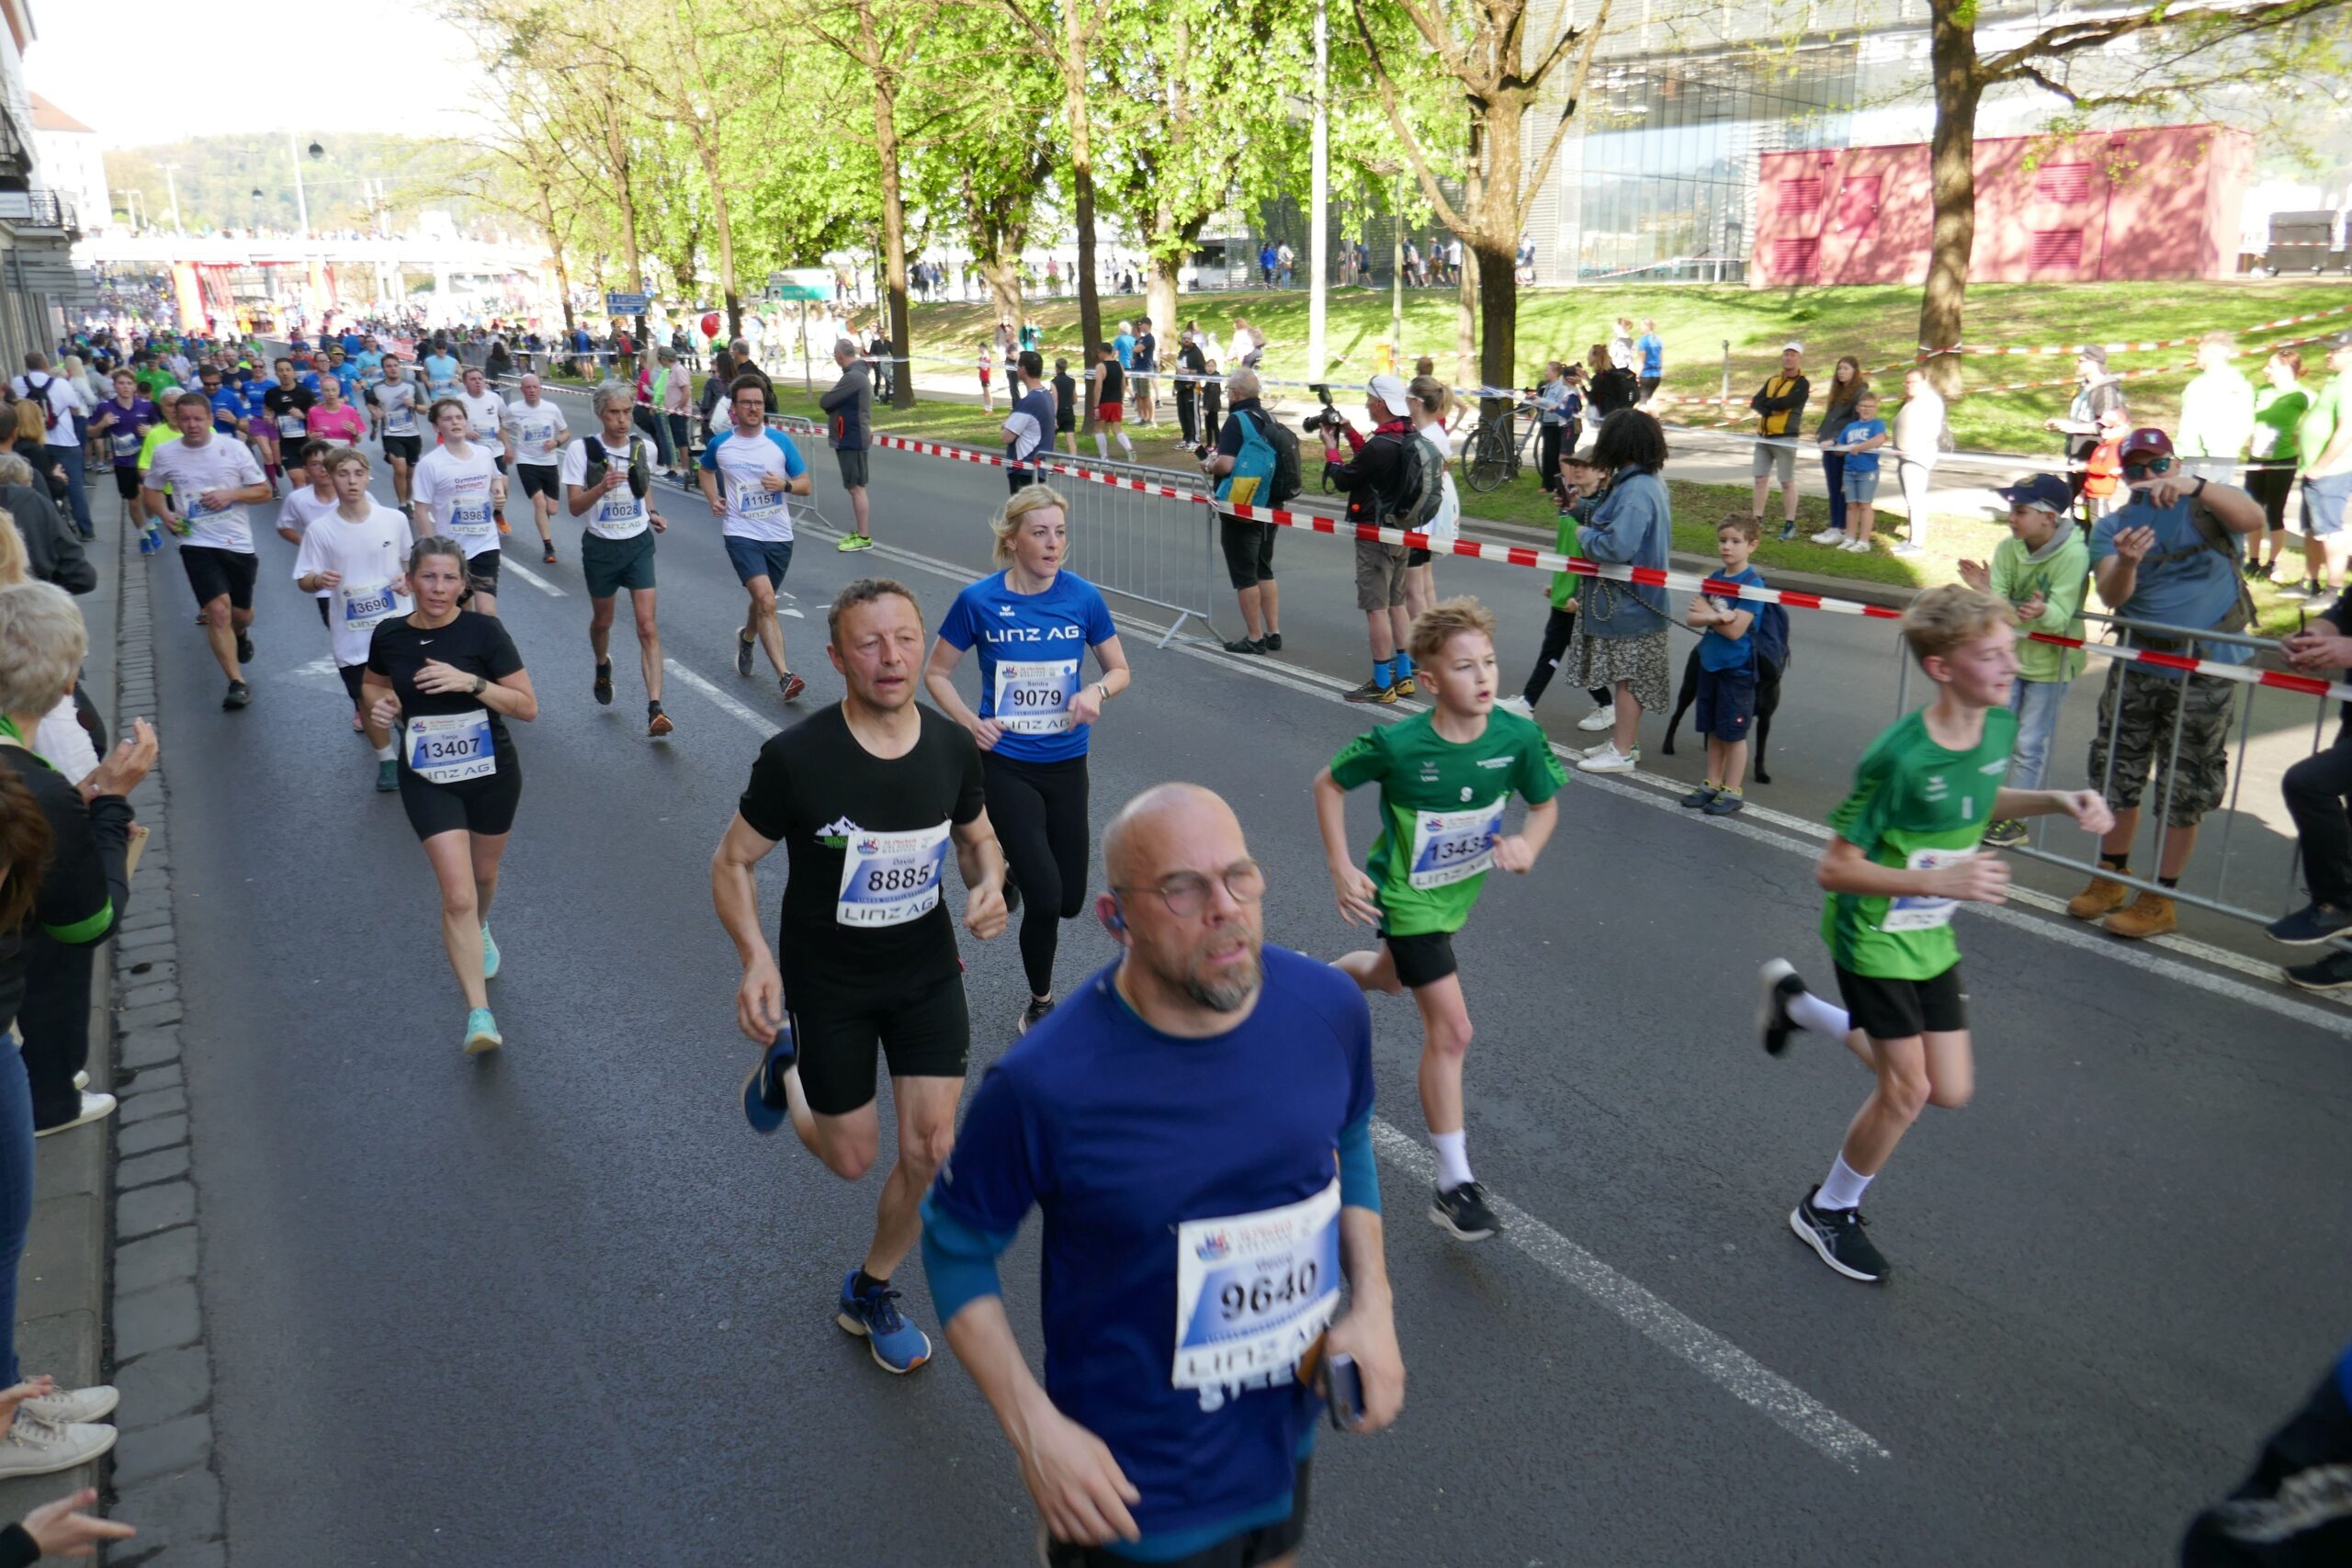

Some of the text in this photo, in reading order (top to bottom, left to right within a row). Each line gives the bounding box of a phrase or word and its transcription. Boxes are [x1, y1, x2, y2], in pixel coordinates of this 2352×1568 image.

[745, 493, 775, 506] 11157
[457, 510, 489, 520] 13983
[605, 504, 639, 516] 10028
[349, 597, 389, 614] 13690
[985, 625, 1080, 643] LINZ AG
[1013, 689, 1062, 706] 9079
[420, 738, 480, 759] 13407
[428, 763, 490, 780] INZ AG
[893, 856, 915, 865] David
[867, 864, 930, 891] 8885
[844, 907, 901, 920] LINZ
[906, 897, 934, 916] AG
[1220, 1259, 1317, 1321] 9640
